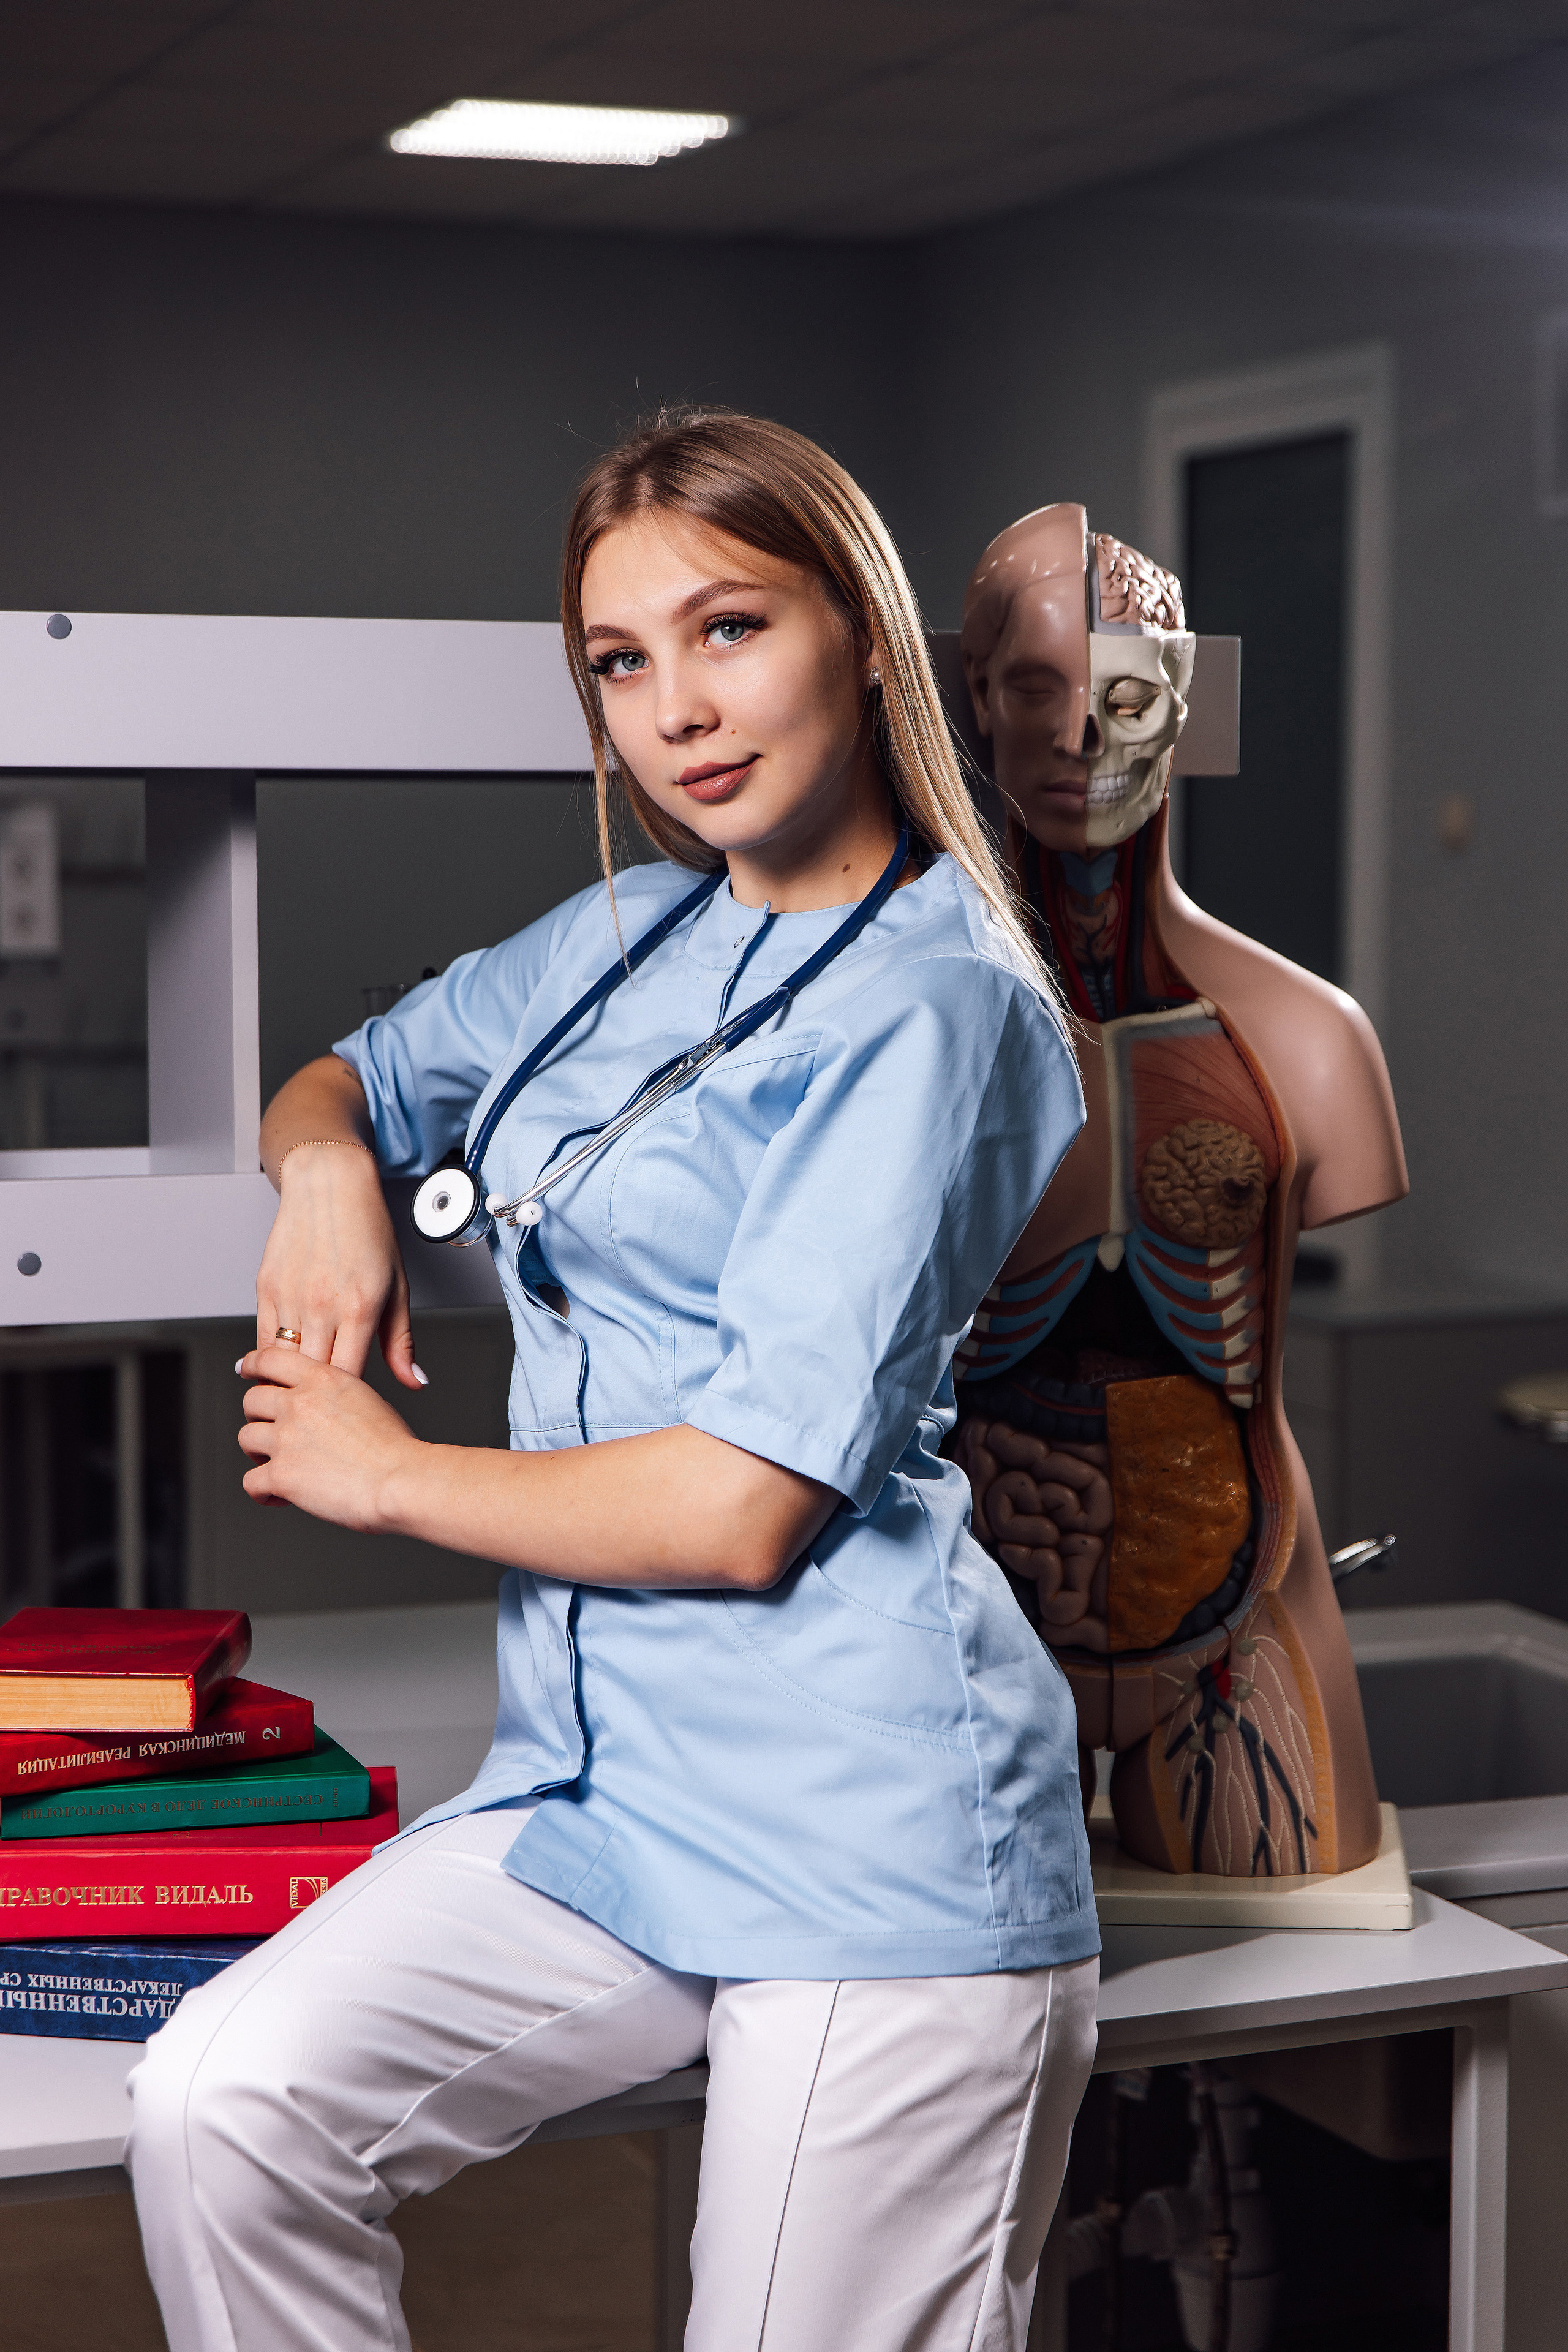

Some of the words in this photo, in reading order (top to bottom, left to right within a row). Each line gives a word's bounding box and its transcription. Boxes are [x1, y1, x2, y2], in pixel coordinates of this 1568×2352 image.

[138, 1730, 246, 1757] МЕДИЦИНСКАЯ
[262, 1726, 281, 1741] 2
[17, 1746, 131, 1776] РЕАБИЛИТАЦИЯ
[20, 1803, 146, 1820] КУРОРТОЛОГИИ
[151, 1801, 160, 1812] В
[165, 1798, 207, 1812] ДЕЛО
[211, 1794, 323, 1810] СЕСТРИНСКОЕ
[154, 1885, 254, 1909] ВИДАЛЬ
[27, 1973, 183, 1997] ЛЕКАРСТВЕННЫХ
[0, 1989, 176, 2019] ДАРСТВЕННЫ
